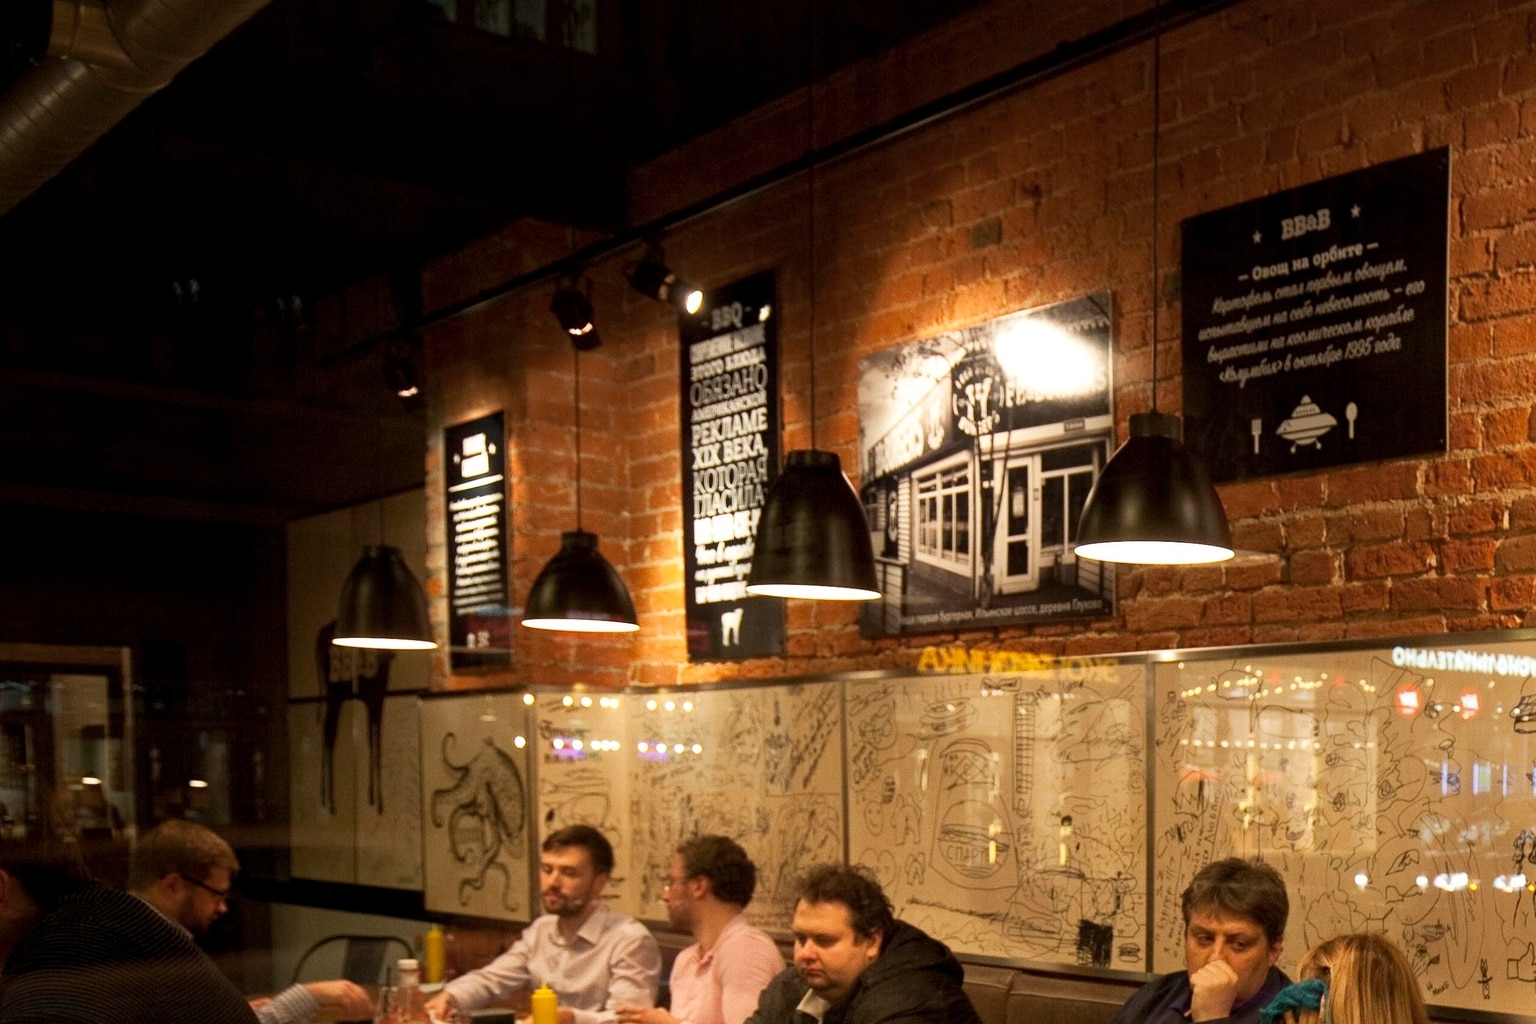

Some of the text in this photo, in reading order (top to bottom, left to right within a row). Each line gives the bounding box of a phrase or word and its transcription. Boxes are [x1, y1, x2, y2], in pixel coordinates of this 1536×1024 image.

[1252, 242, 1363, 281] Овощ на орбите
[690, 363, 768, 407] ОБЯЗАНО
[691, 407, 768, 447] РЕКЛАМЕ
[693, 457, 768, 495] КОТОРАЯ
